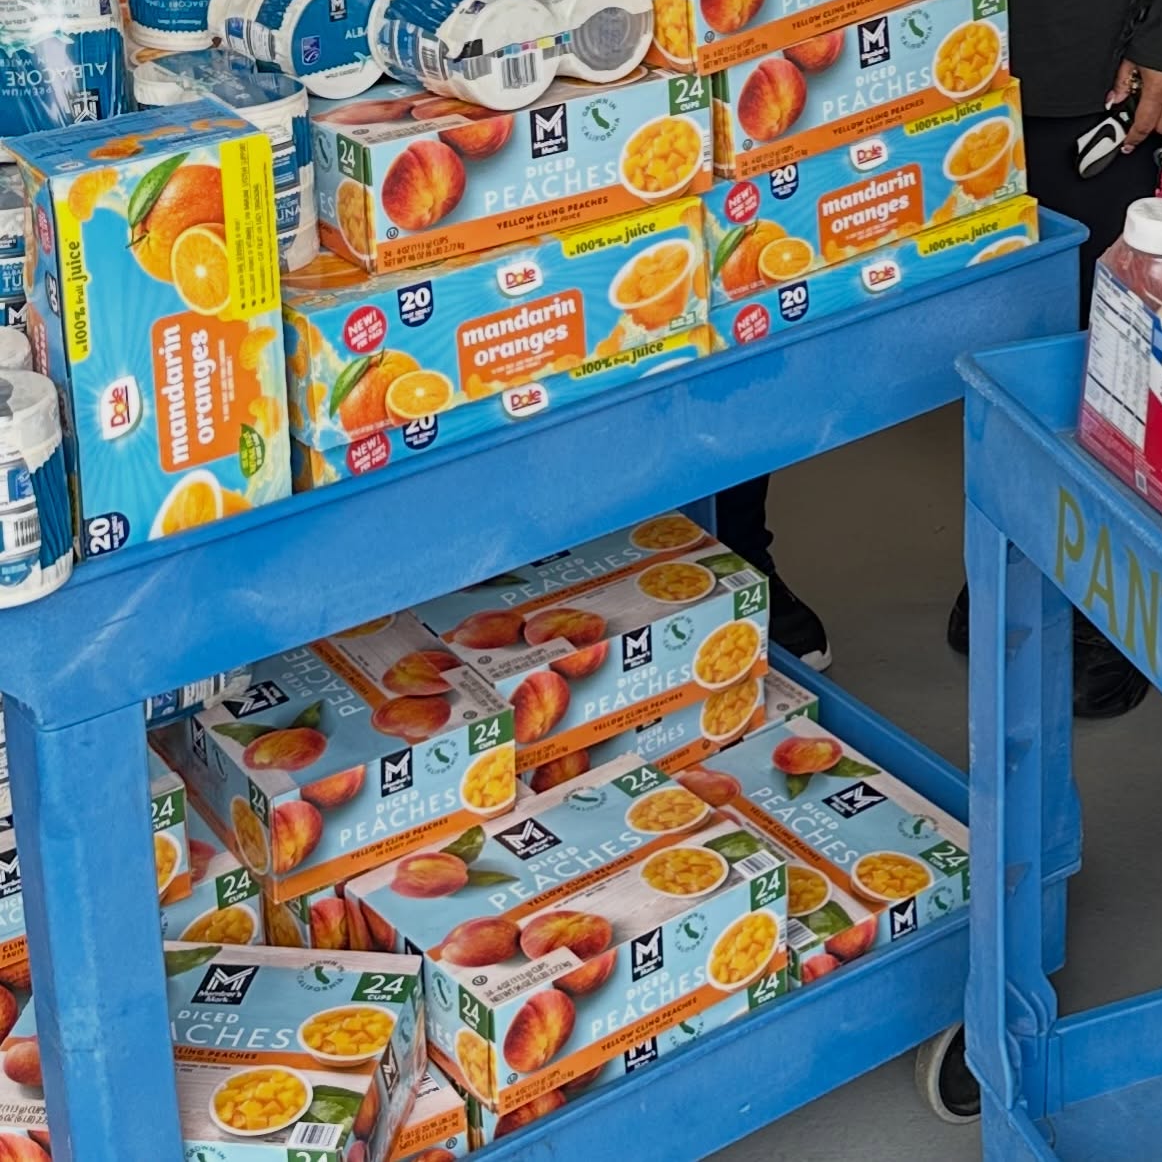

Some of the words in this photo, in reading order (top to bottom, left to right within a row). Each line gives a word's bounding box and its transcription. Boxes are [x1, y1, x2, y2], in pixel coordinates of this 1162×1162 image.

[792, 13, 822, 30] YELLOW
[822, 6, 846, 22] CLING
[856, 65, 897, 88] DICED
[674, 79, 705, 103] 24
[822, 67, 932, 121] PEACHES
[678, 99, 700, 112] CUPS
[914, 116, 940, 133] 100%
[954, 99, 984, 123] juice
[856, 144, 884, 163] Dole
[525, 157, 576, 180] DICED
[771, 165, 797, 185] 20
[484, 163, 617, 213] PEACHES
[821, 169, 917, 218] mandarin
[497, 214, 533, 231] YELLOW
[534, 206, 564, 222] CLING
[566, 195, 609, 216] PEACHES
[830, 193, 910, 235] oranges
[575, 235, 606, 255] 100%
[624, 220, 657, 245] juice
[927, 236, 956, 255] 100%
[968, 220, 999, 244] juice
[505, 267, 536, 287] Dole
[868, 264, 897, 284] Dole
[401, 288, 431, 312] 20
[781, 286, 806, 307] 20
[347, 311, 379, 338] NEW!
[462, 295, 577, 346] mandarin
[474, 324, 570, 368] oranges
[580, 356, 613, 377] 100%
[630, 340, 665, 366] juice
[160, 323, 190, 465] mandarin
[190, 328, 216, 446] oranges
[87, 517, 111, 554] 20
[738, 588, 763, 611] 24
[584, 662, 692, 719] PEACHES
[473, 719, 501, 741] 24
[375, 789, 419, 815] DICED
[339, 788, 458, 847] PEACHES
[749, 786, 859, 865] PEACHES
[350, 843, 382, 859] YELLOW
[384, 833, 412, 850] CLING
[412, 817, 449, 838] PEACHES
[487, 828, 643, 912] PEACHES
[527, 846, 580, 873] DICED
[222, 874, 252, 898] 24
[228, 892, 249, 904] CUPS
[756, 871, 781, 899] 24
[367, 974, 405, 995] 24
[367, 993, 392, 1002] CUPS
[177, 1009, 240, 1025] DICED
